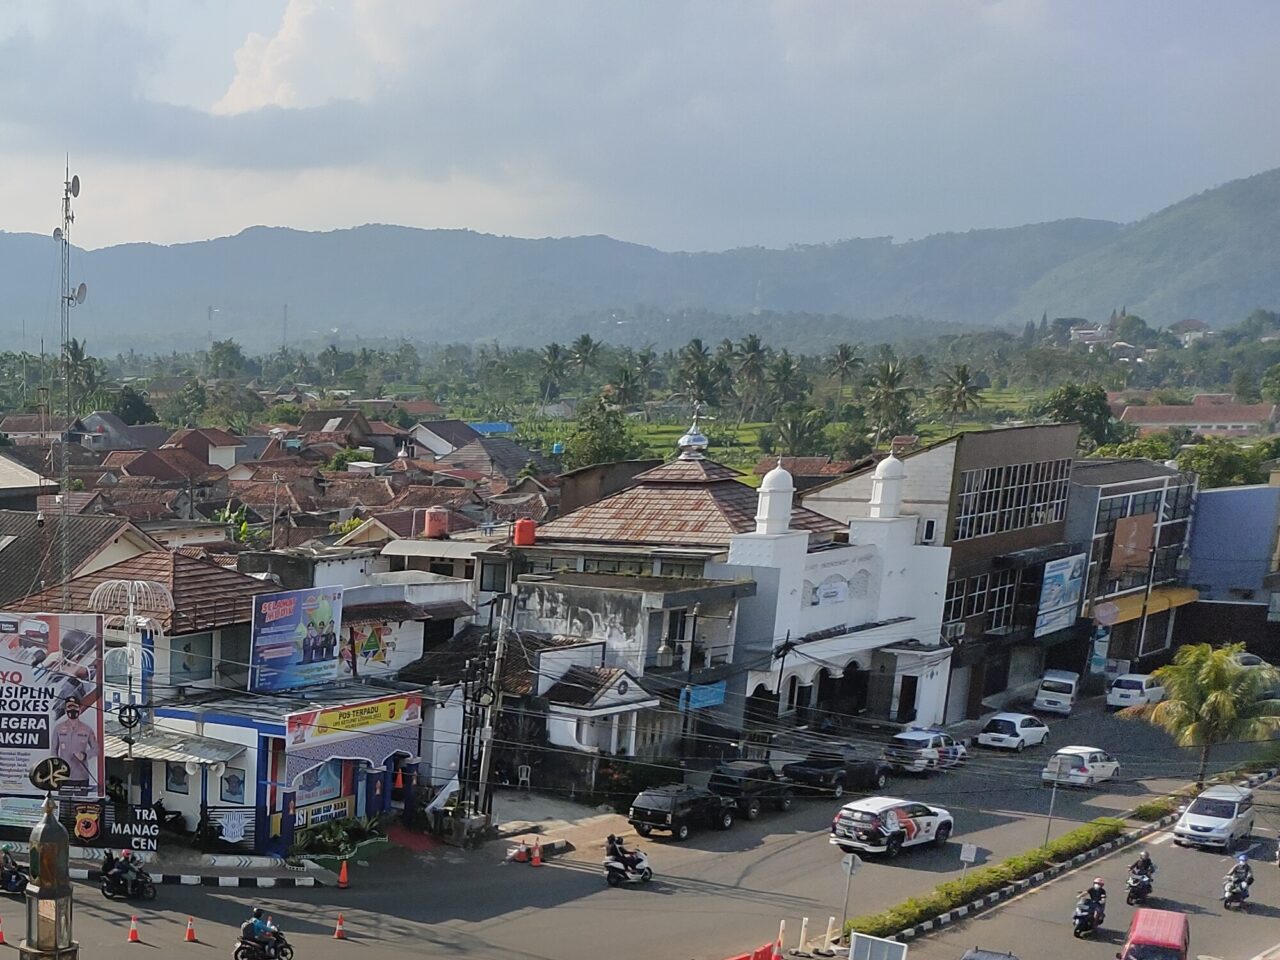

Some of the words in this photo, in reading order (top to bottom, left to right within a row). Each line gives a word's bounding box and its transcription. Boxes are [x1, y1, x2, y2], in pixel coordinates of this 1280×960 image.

[338, 712, 351, 720] POS
[352, 706, 379, 718] TERPADU
[135, 808, 158, 821] TRA
[111, 823, 160, 836] MANAG
[132, 838, 158, 850] CEN
